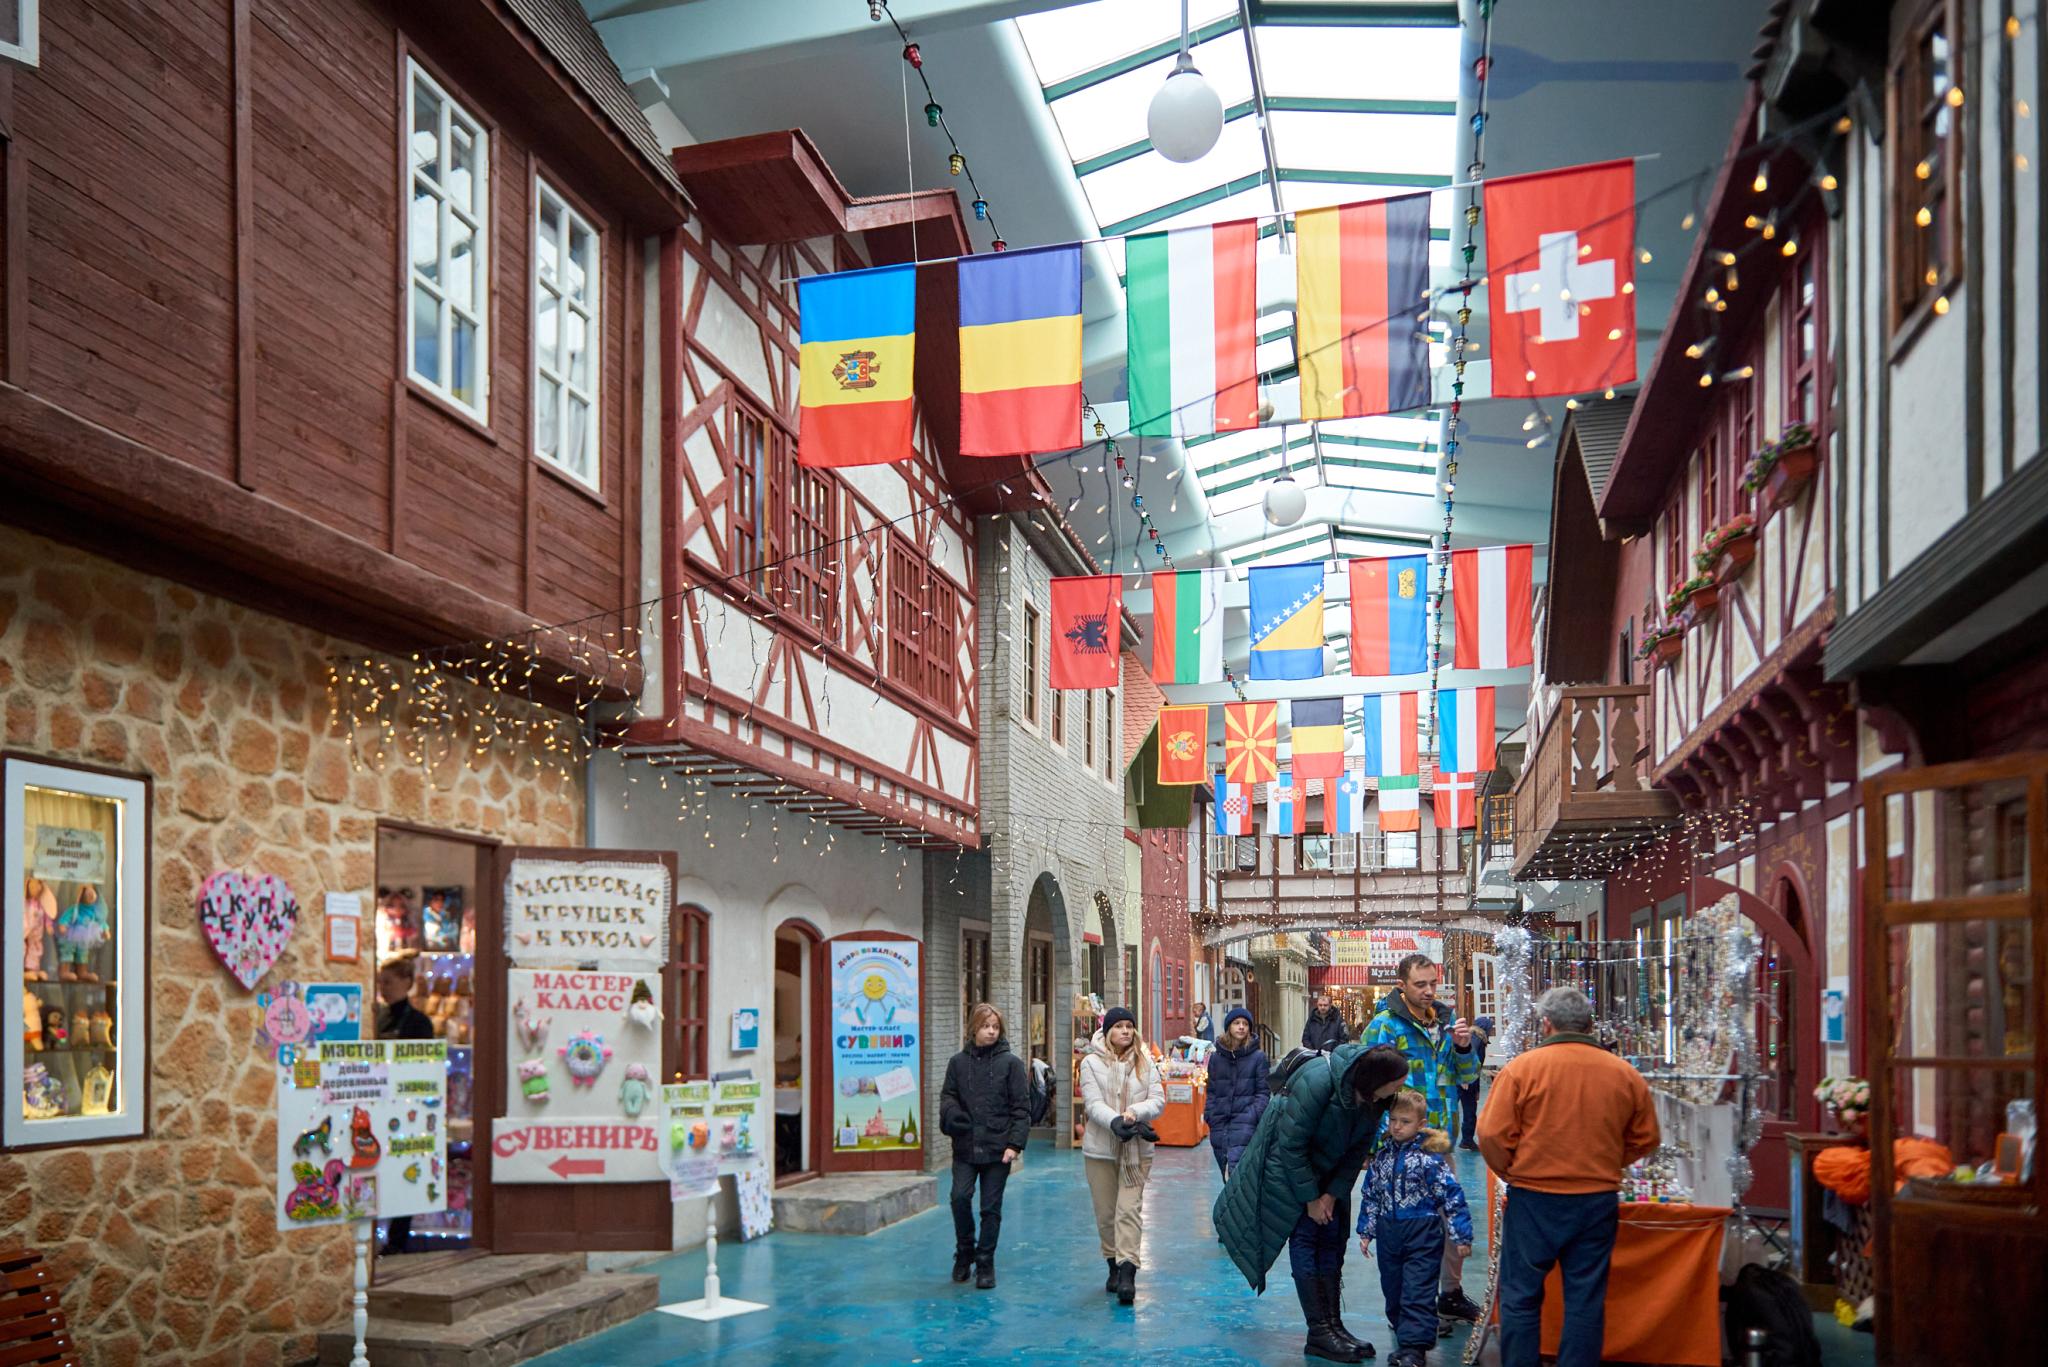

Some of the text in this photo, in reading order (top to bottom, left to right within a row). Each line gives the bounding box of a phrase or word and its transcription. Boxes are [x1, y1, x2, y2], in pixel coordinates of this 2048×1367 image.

[514, 875, 661, 906] МАСТЕРСКАЯ
[524, 905, 646, 924] ИГРУШЕК
[535, 929, 637, 948] И КУКОЛ
[533, 972, 632, 992] МАСТЕР
[537, 992, 624, 1012] КЛАСС
[320, 1042, 444, 1059] мастер класс
[836, 1033, 916, 1049] СУВЕНИР
[338, 1064, 370, 1076] декор
